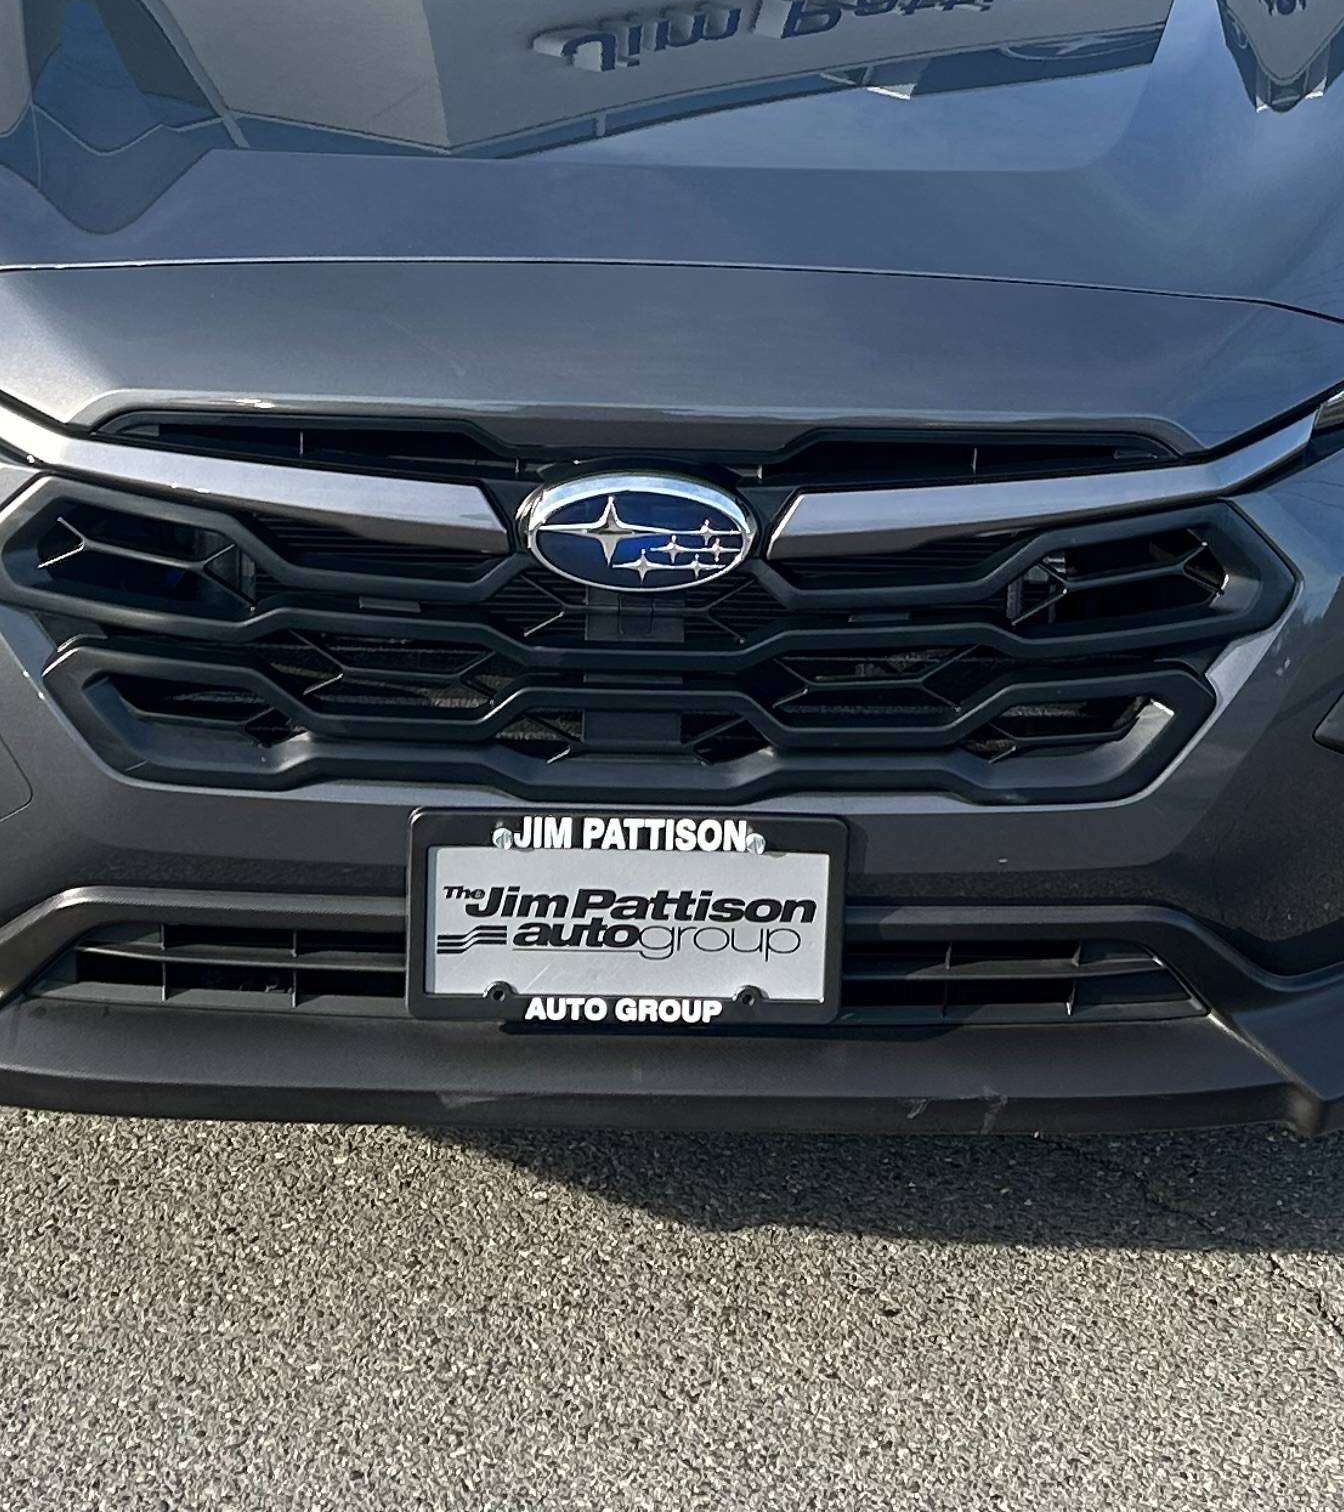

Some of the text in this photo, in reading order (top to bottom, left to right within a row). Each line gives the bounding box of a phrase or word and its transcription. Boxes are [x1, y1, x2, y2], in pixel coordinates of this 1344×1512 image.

[514, 816, 748, 853] JIM PATTISON
[443, 885, 486, 900] The
[524, 998, 723, 1024] AUTO GROUP
